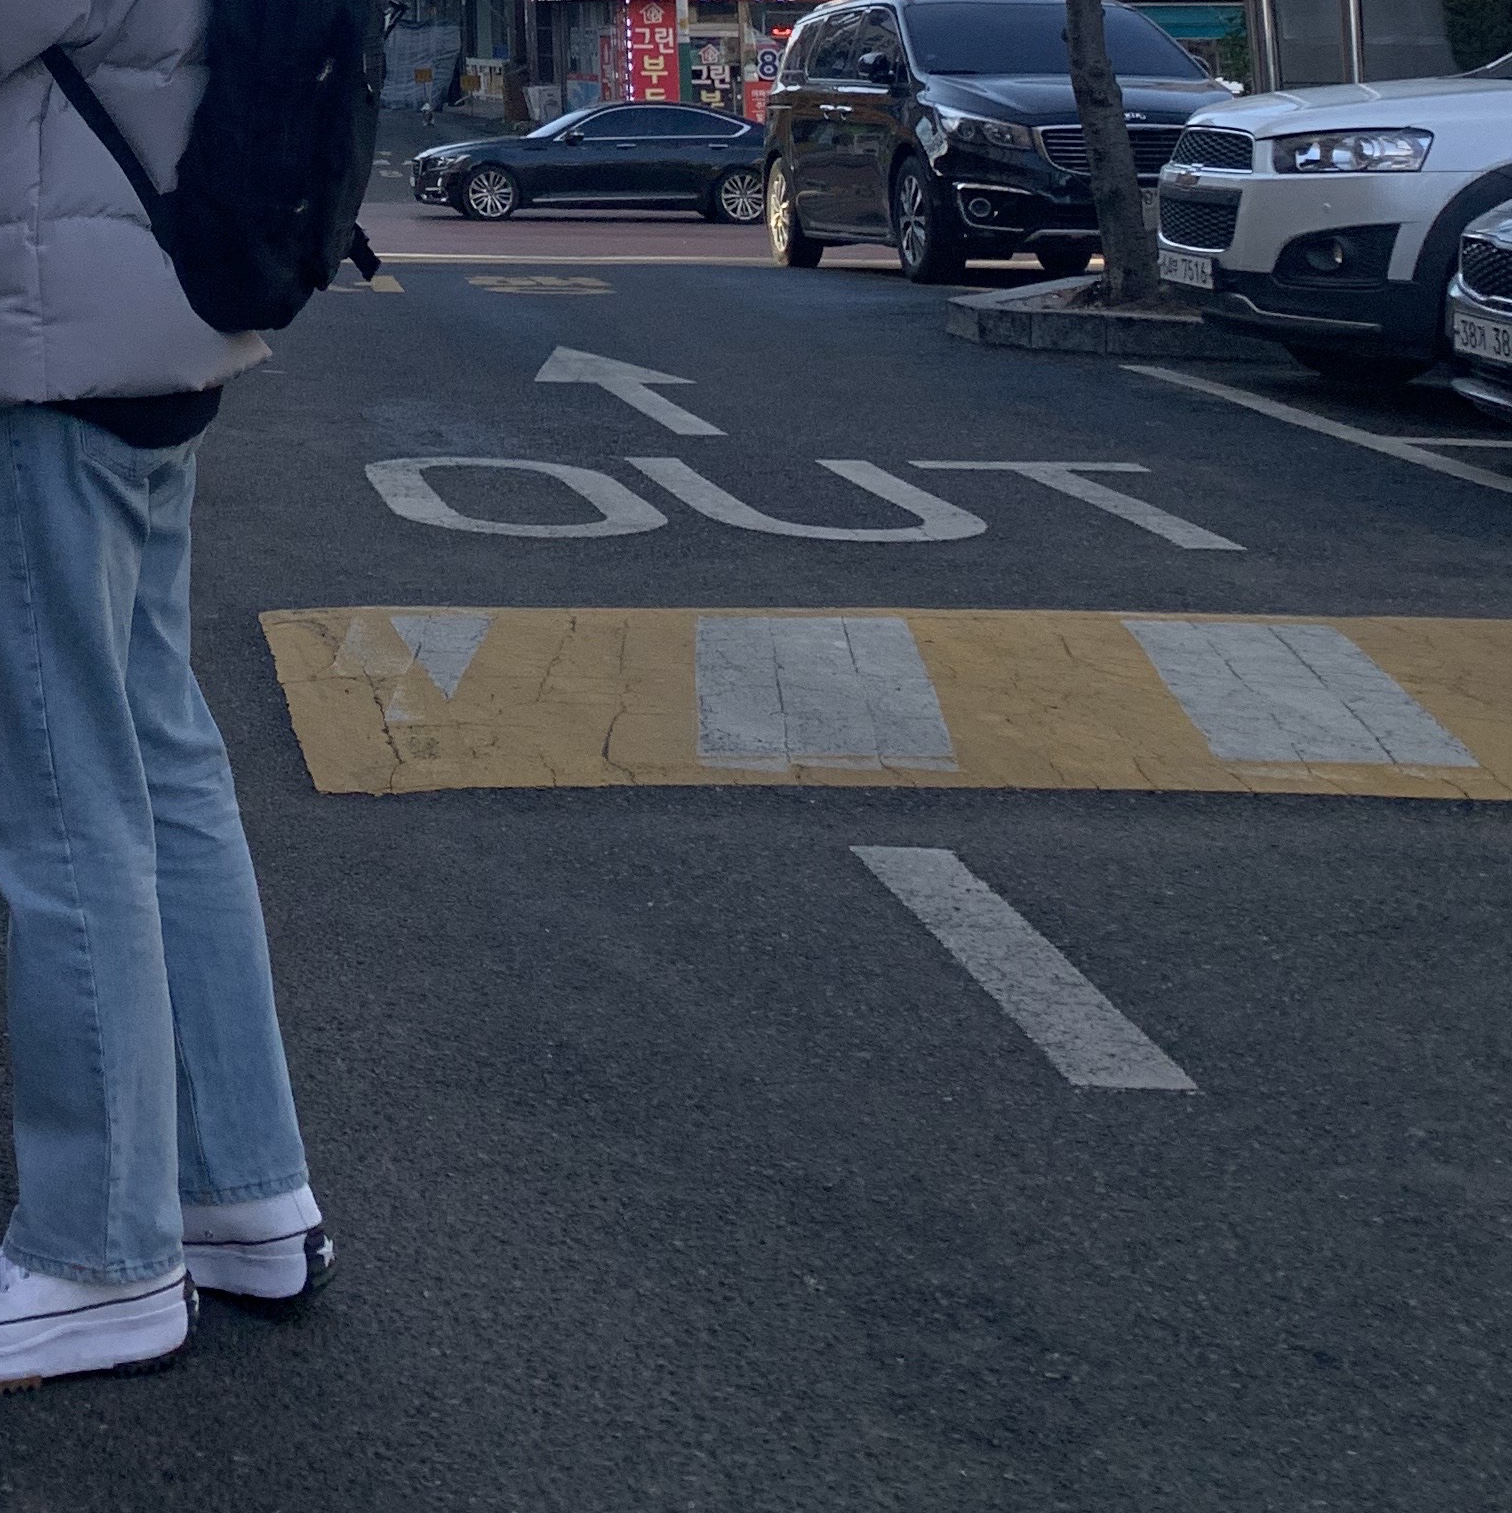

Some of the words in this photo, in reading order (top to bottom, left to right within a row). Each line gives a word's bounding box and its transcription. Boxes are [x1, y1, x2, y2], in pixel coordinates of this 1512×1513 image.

[633, 27, 675, 54] 그린
[691, 65, 731, 88] 그린
[365, 455, 1247, 551] OUT
